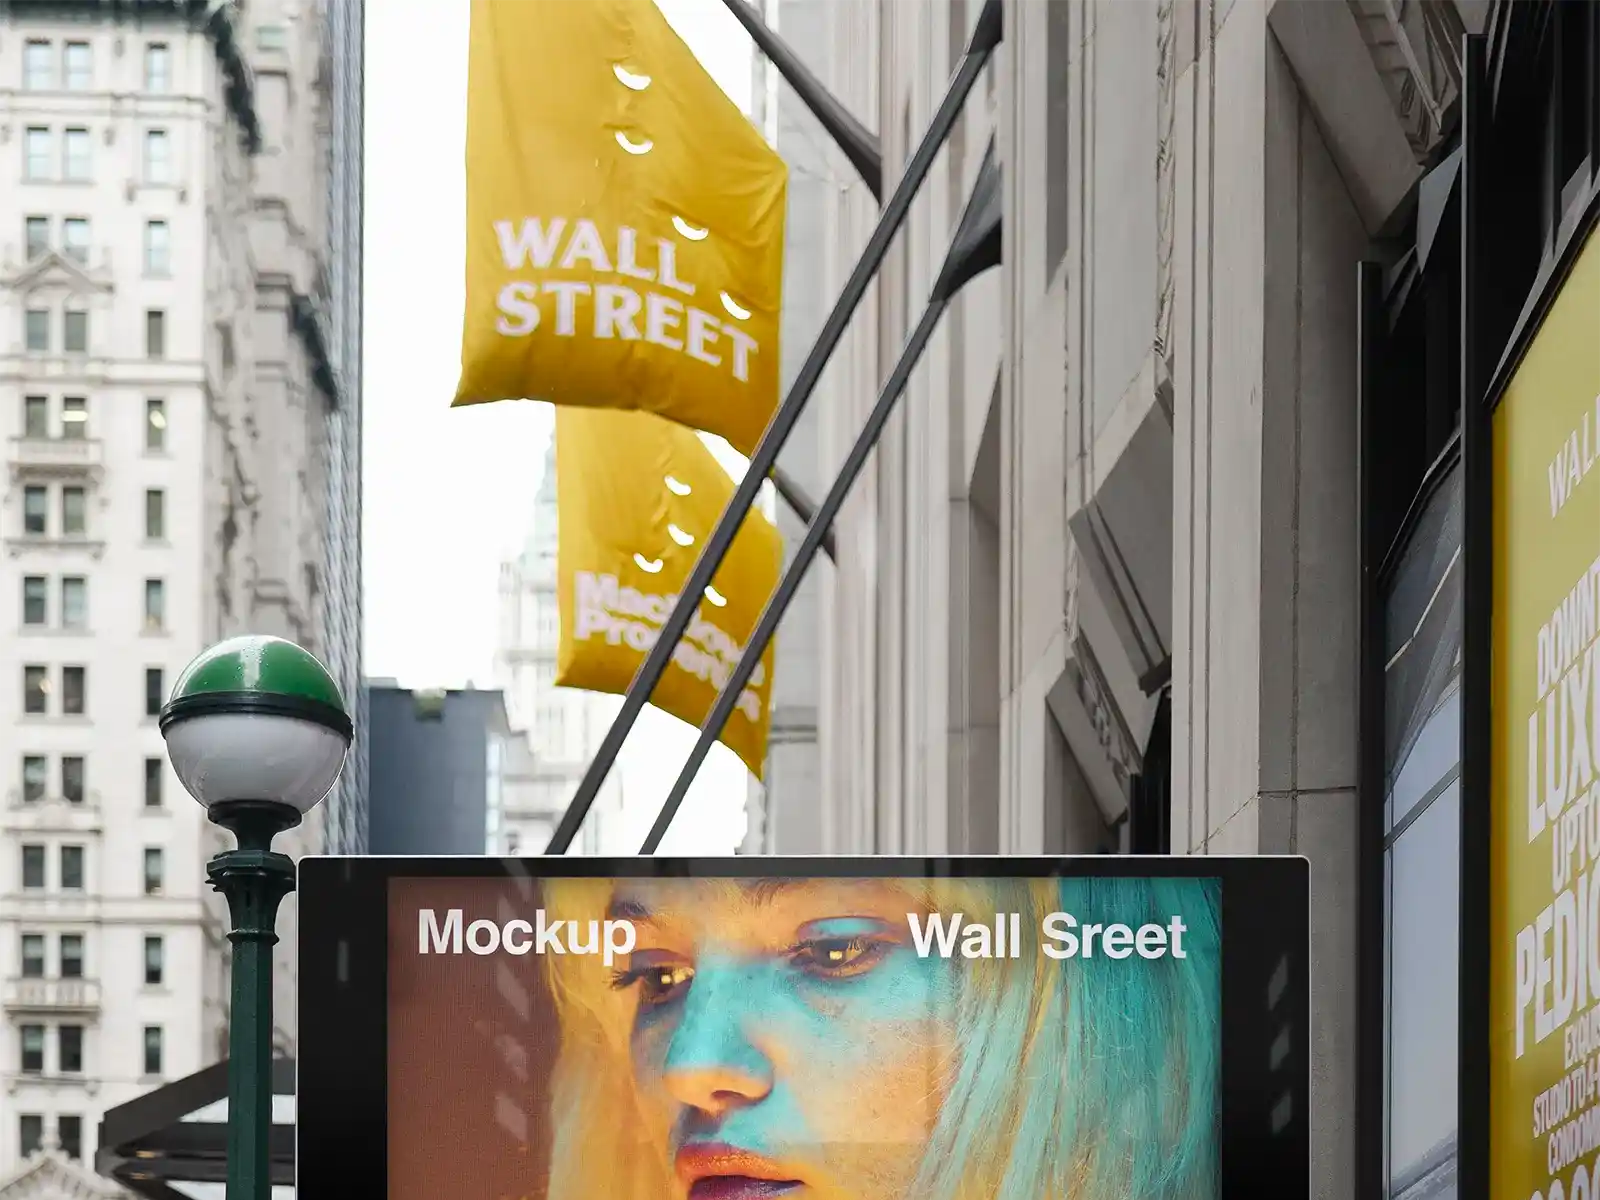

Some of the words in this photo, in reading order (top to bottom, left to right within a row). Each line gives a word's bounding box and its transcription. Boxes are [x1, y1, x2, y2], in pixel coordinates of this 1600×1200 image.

[493, 216, 696, 296] WALL
[496, 280, 759, 383] STREET
[418, 908, 636, 967] Mockup
[906, 912, 1020, 959] Wall
[1041, 911, 1187, 960] Sreet
